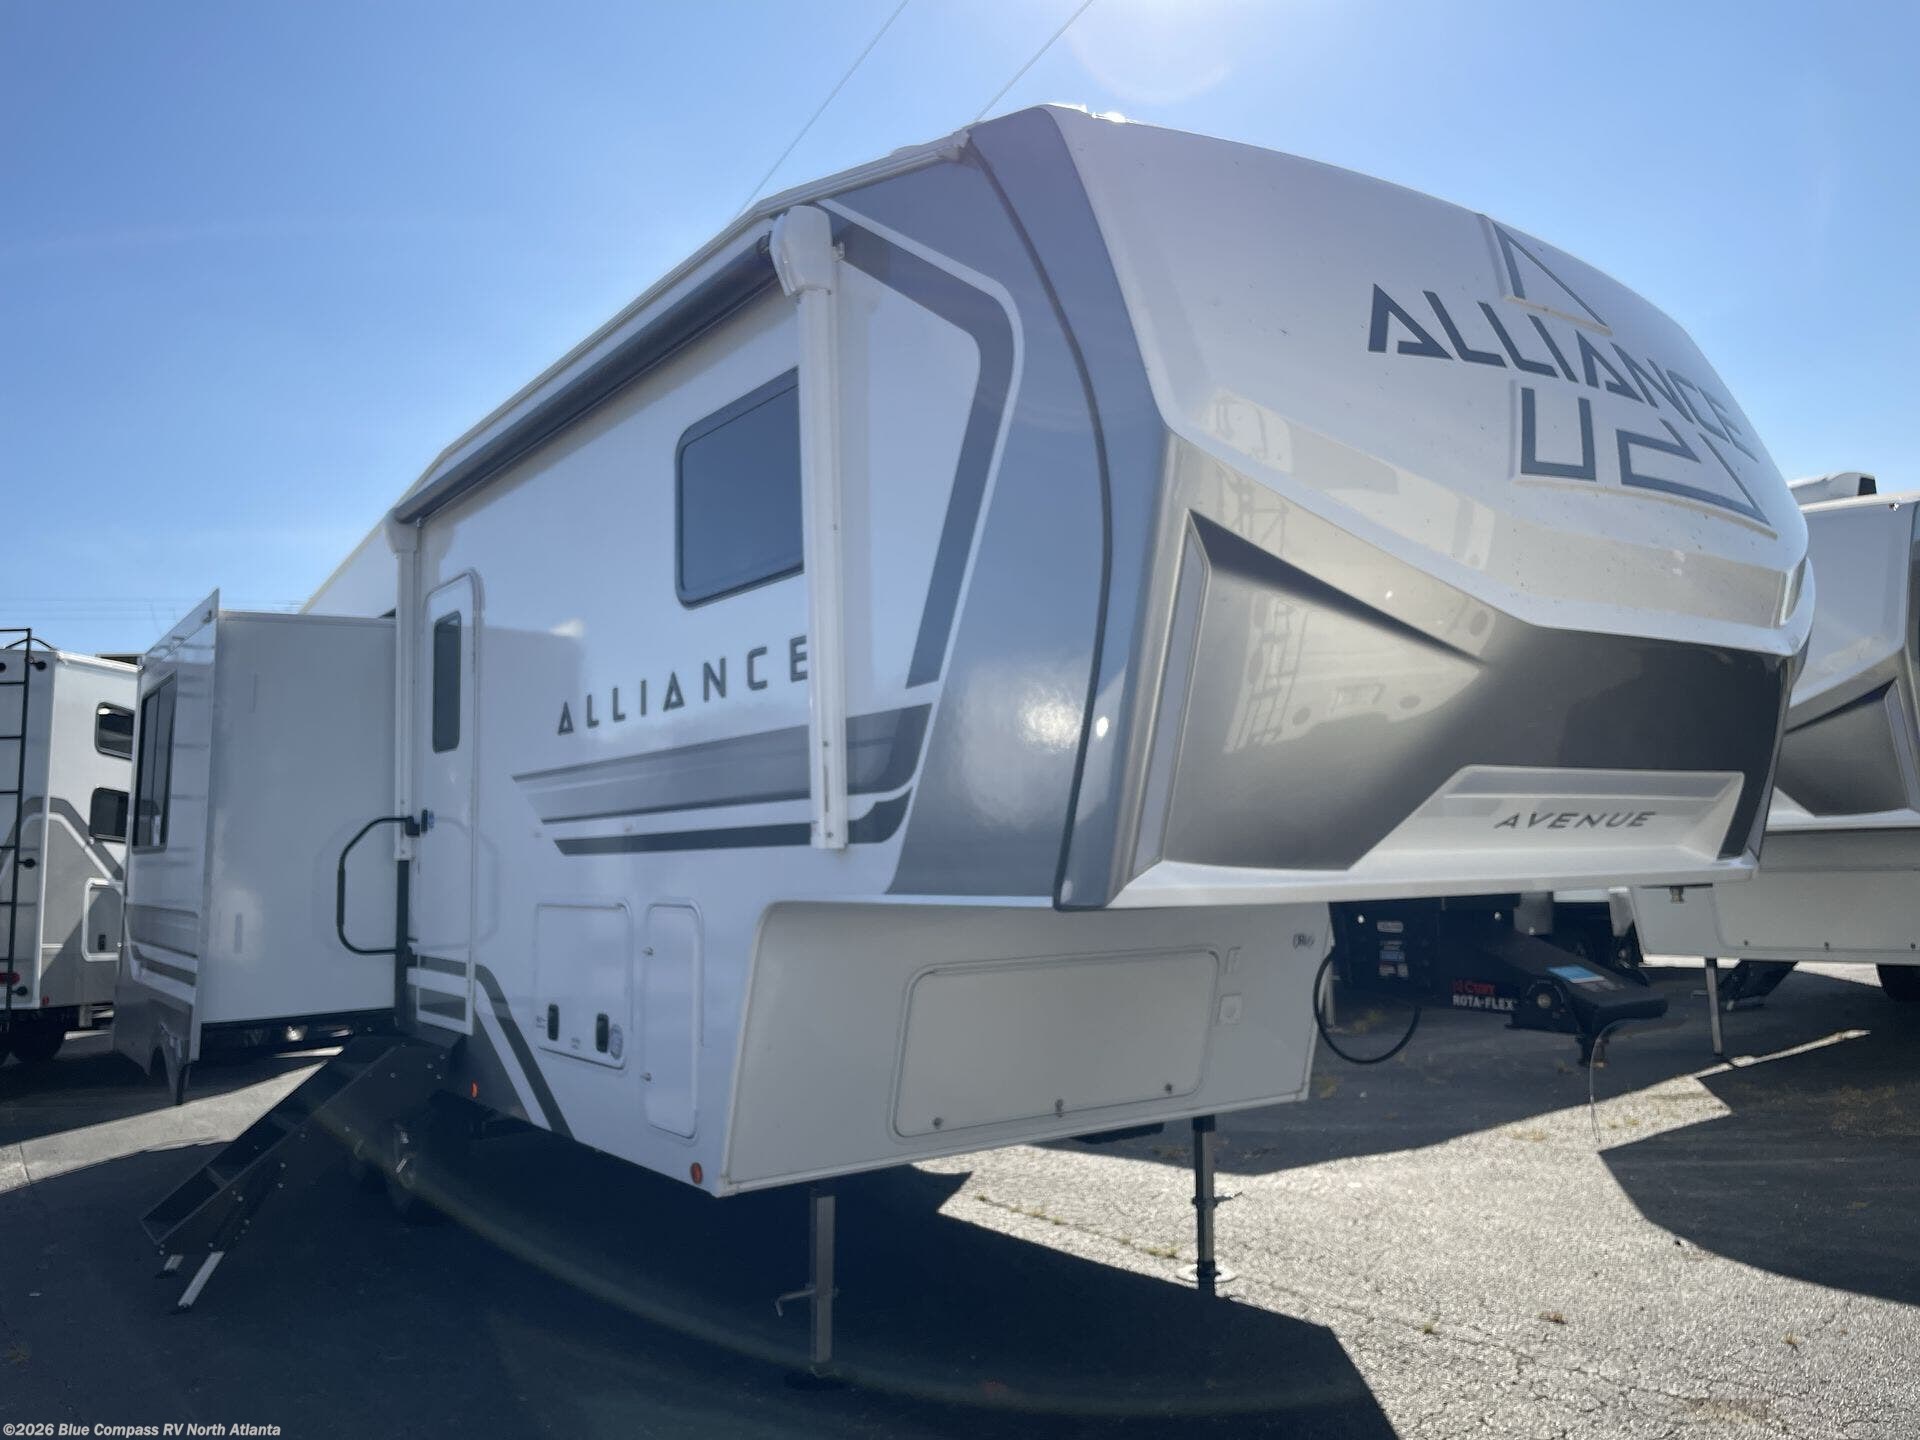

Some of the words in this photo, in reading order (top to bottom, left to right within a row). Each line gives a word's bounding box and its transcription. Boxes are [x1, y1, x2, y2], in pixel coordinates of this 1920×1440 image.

[1367, 283, 1758, 463] ALLIANCE
[557, 634, 808, 736] ALLIANCE
[1493, 811, 1657, 829] AVENUE
[1453, 994, 1514, 1011] ROTA-FLEX
